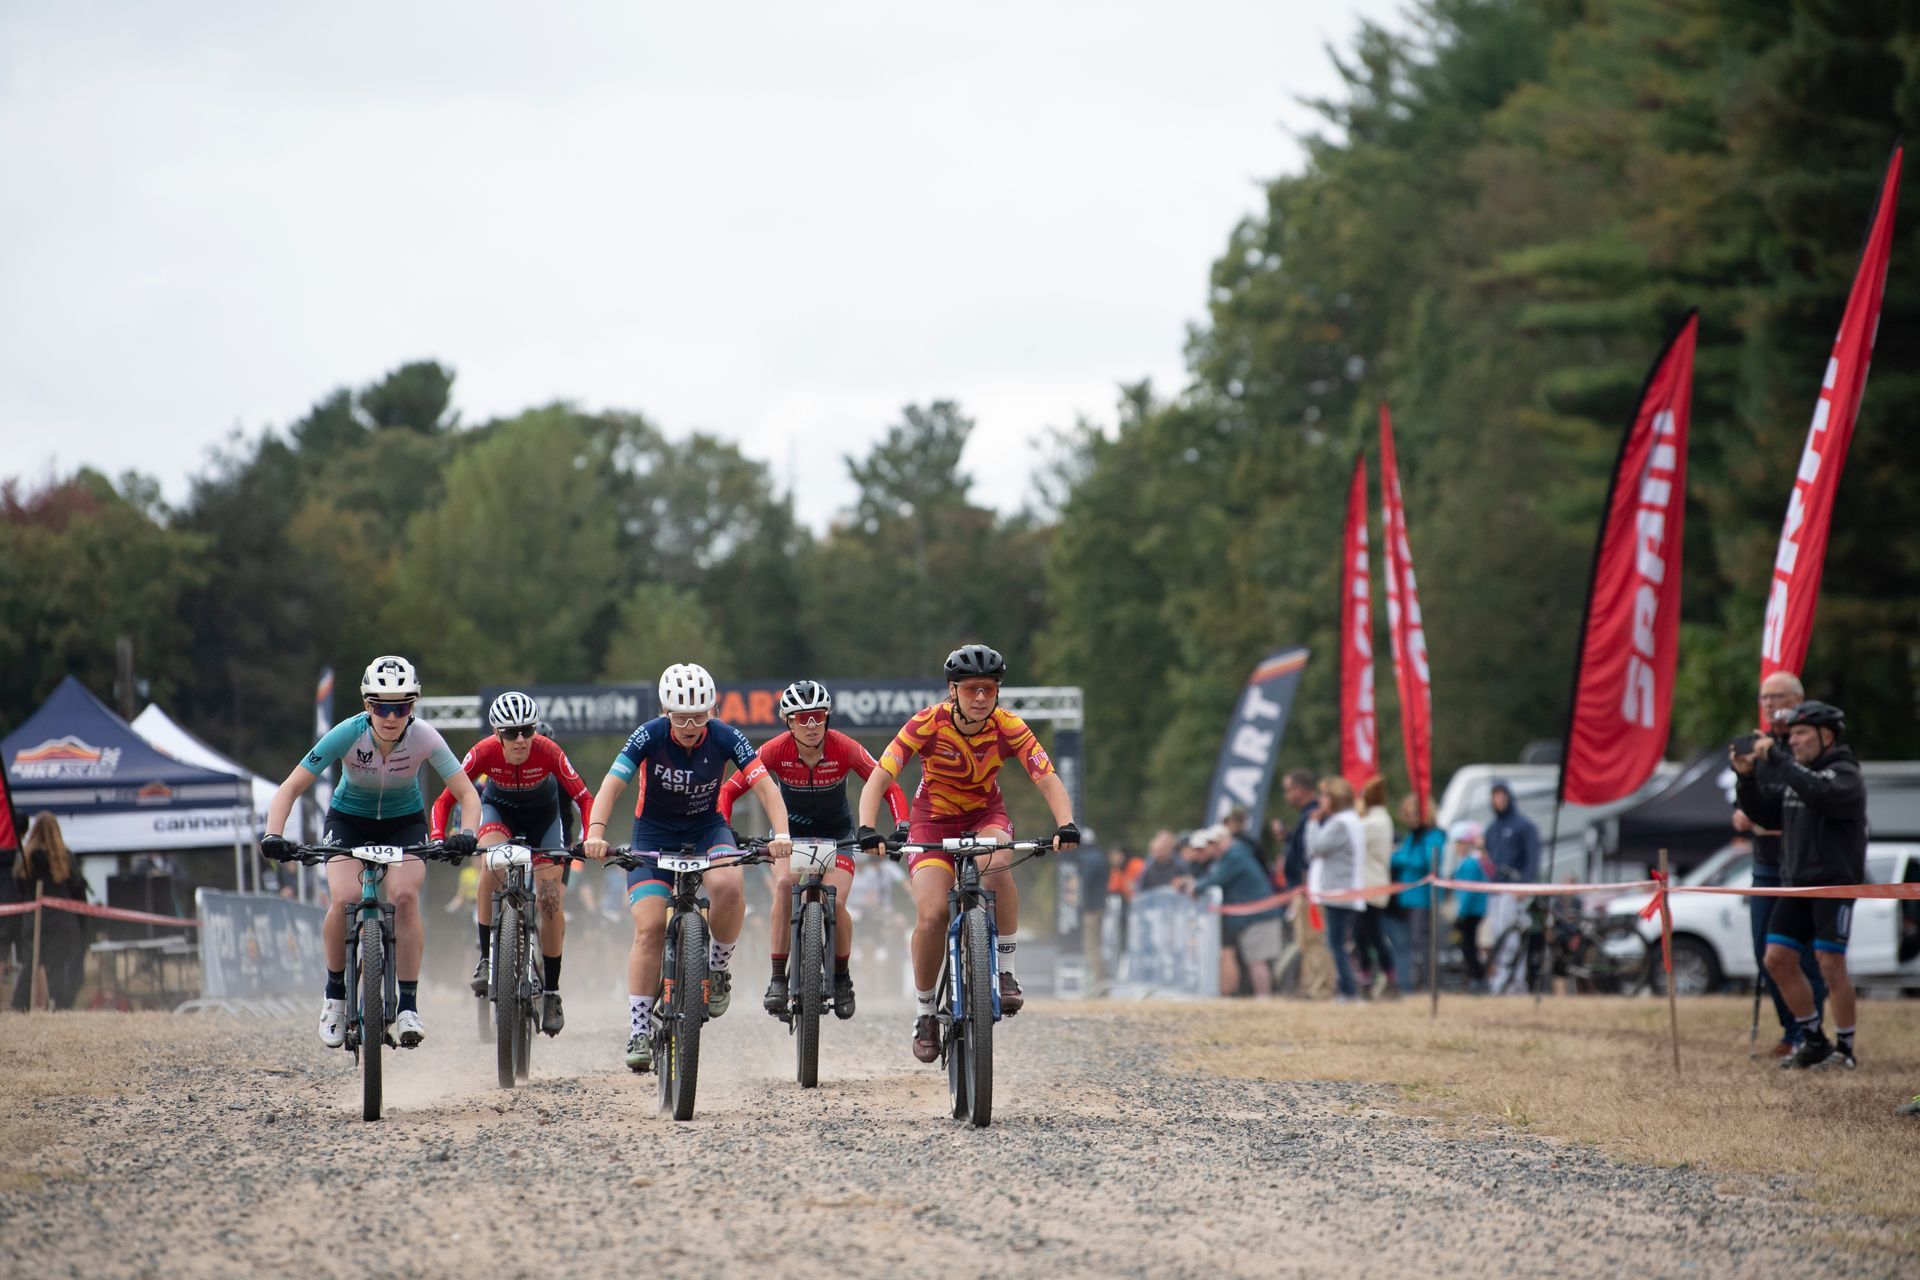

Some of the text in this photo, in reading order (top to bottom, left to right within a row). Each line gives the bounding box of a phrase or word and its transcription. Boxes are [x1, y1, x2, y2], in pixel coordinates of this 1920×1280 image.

[1762, 330, 1841, 665] SRA
[633, 730, 651, 750] FAST
[733, 729, 755, 757] SPLITS
[733, 741, 747, 764] FAST
[654, 763, 694, 785] FAST
[661, 778, 718, 795] SPLITS
[504, 846, 513, 859] 3
[808, 845, 819, 865] 7
